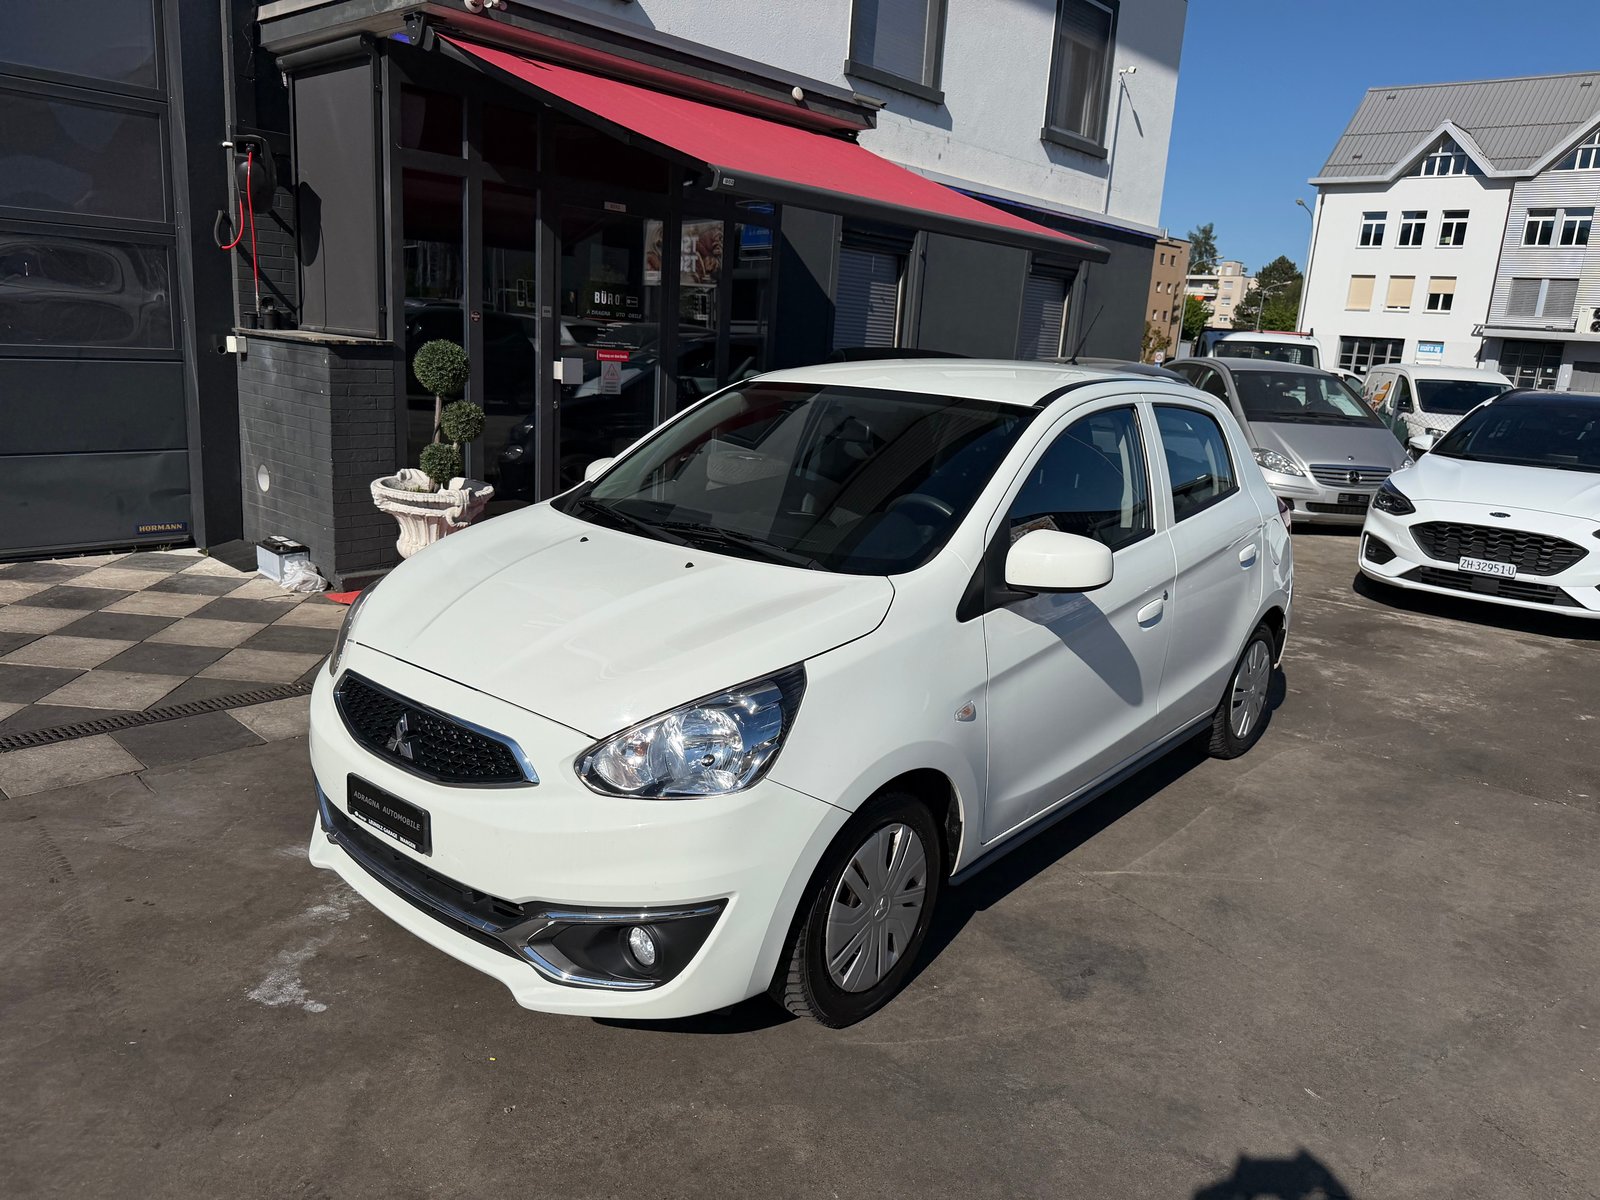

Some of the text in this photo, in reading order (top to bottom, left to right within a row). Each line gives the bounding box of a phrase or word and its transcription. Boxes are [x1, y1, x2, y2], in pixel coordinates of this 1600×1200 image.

[594, 290, 620, 305] BÜRO
[353, 790, 380, 810] ADRAGNA
[382, 806, 421, 831] AUTOMOBILE
